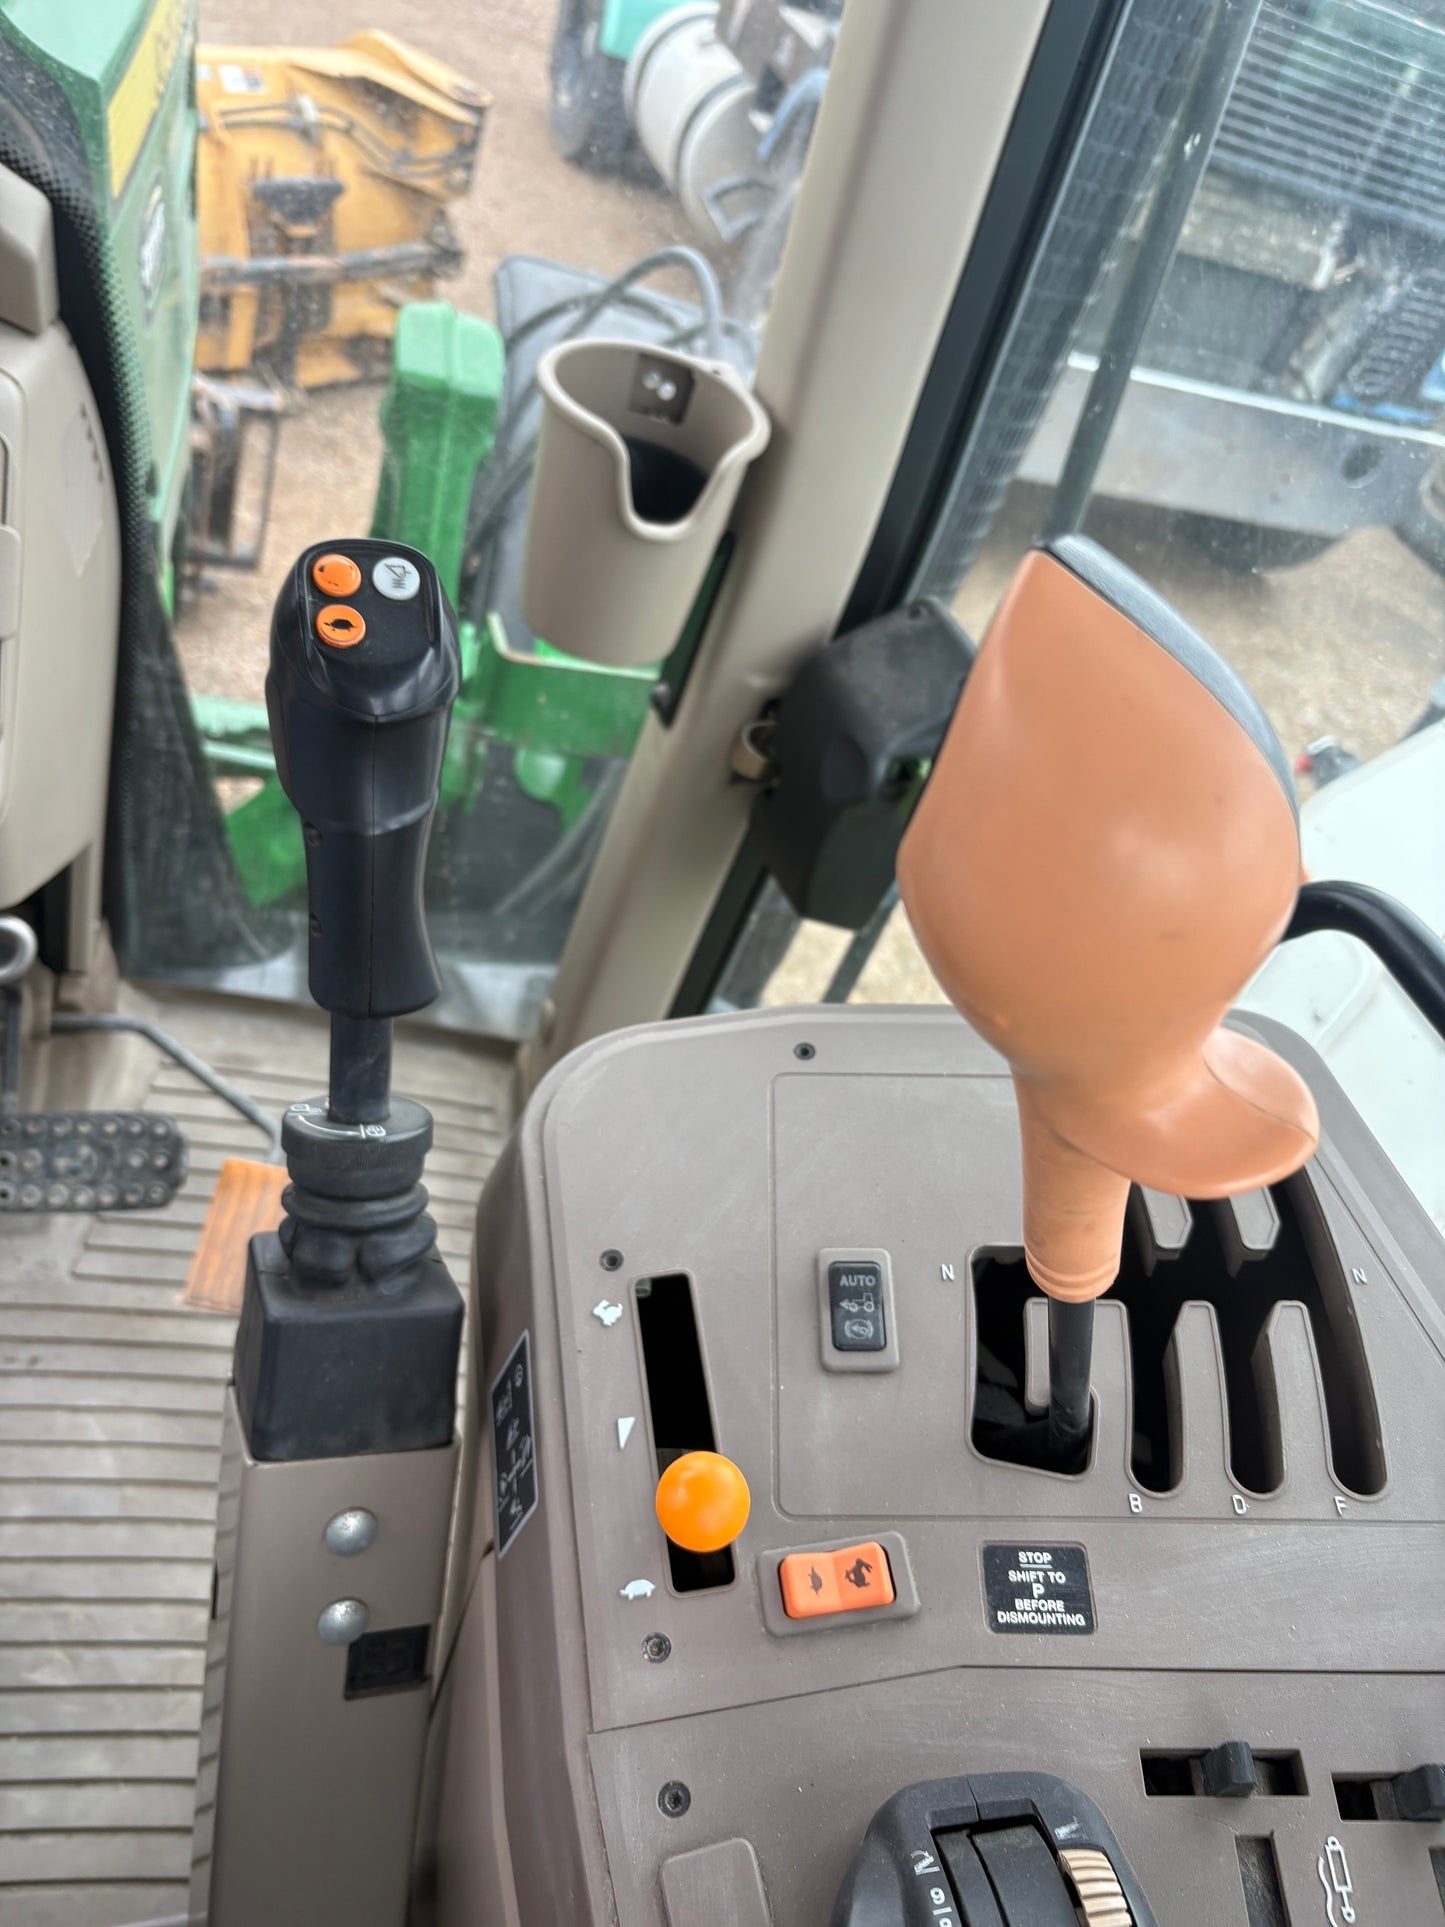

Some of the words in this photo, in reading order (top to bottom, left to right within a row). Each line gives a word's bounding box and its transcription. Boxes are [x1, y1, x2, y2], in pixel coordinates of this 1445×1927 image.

[941, 1263, 955, 1280] N
[1351, 1267, 1367, 1283] N
[840, 1274, 876, 1287] AUTO
[1128, 1493, 1142, 1513] B
[1232, 1494, 1247, 1515] D
[1334, 1496, 1347, 1517] F
[1018, 1551, 1052, 1564] STOP
[1008, 1570, 1045, 1583] SHIFT
[1047, 1571, 1066, 1584] TO
[1032, 1582, 1045, 1599] P
[1014, 1598, 1065, 1612] BEFORE
[997, 1611, 1086, 1626] DISMOUNTING
[930, 1887, 946, 1905] 9
